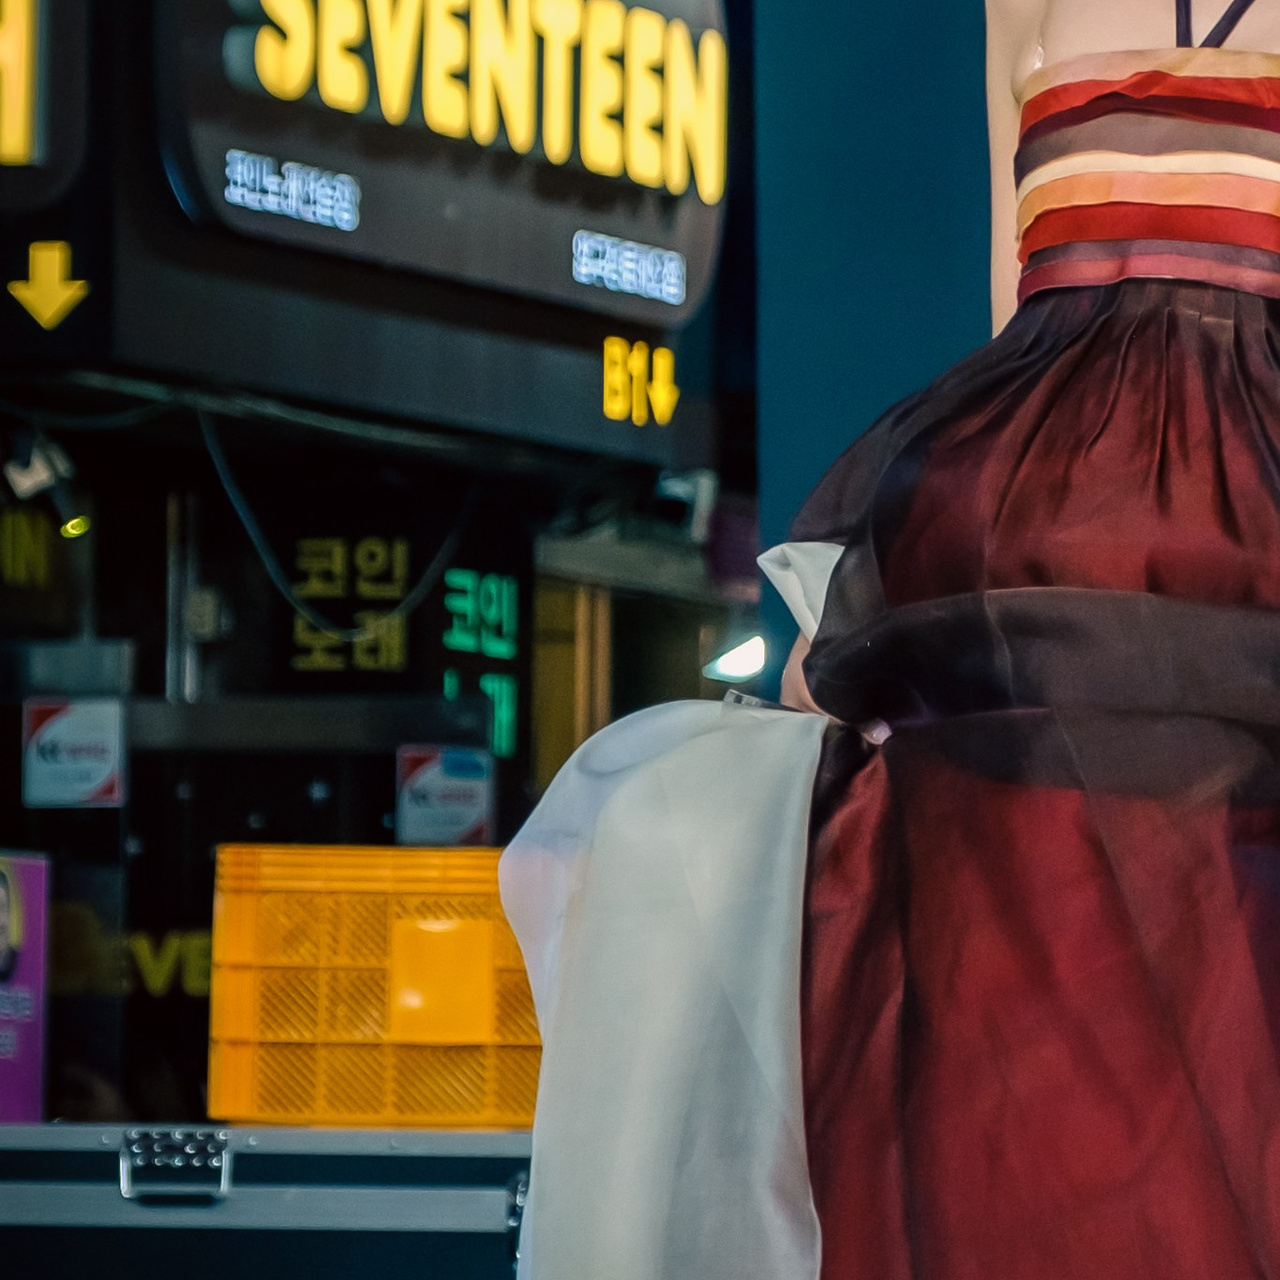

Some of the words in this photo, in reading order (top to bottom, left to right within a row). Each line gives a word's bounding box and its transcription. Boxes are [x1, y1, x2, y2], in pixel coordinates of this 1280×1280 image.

[603, 336, 649, 427] B1
[292, 536, 410, 599] 코인
[442, 567, 518, 660] 코인
